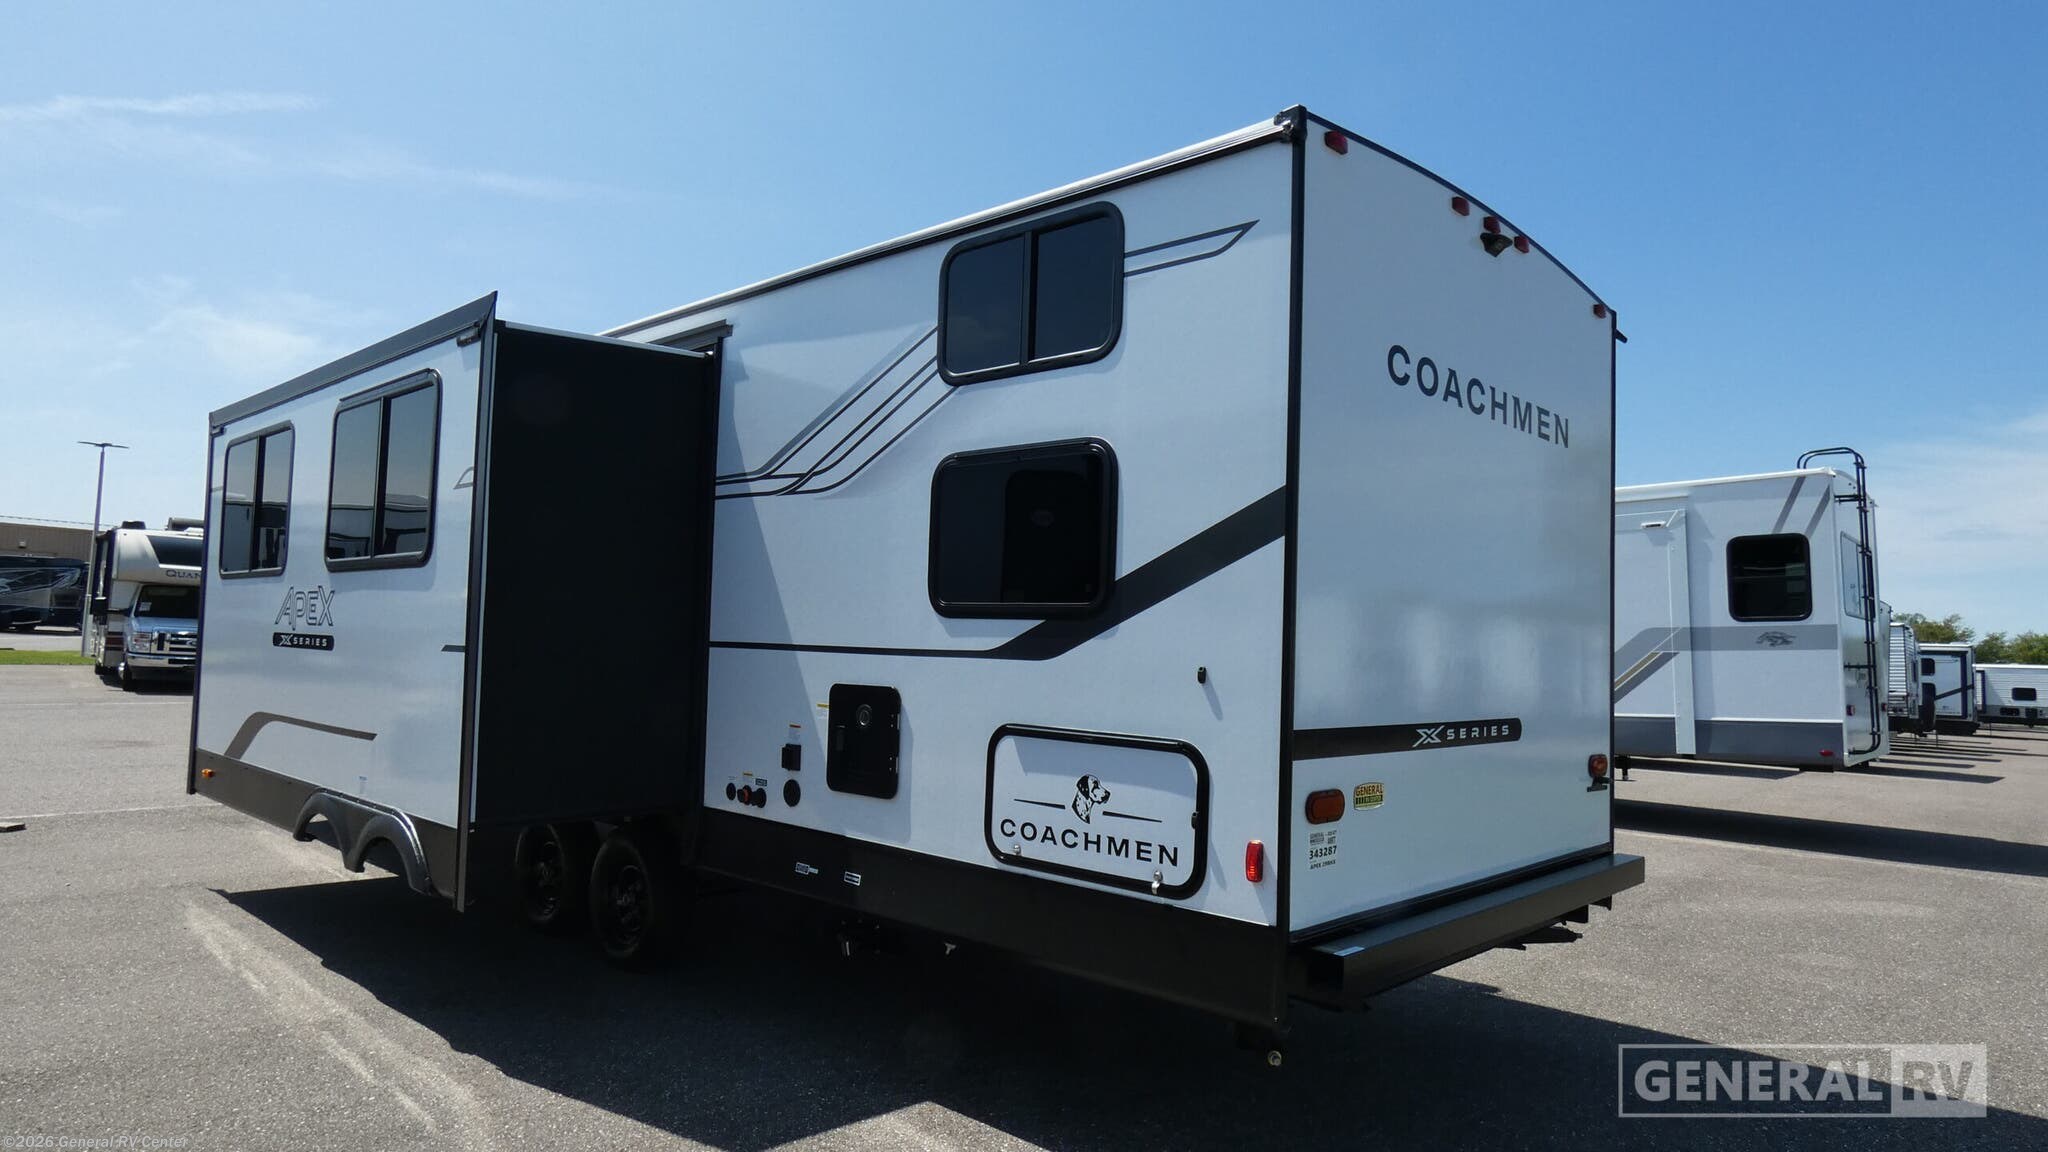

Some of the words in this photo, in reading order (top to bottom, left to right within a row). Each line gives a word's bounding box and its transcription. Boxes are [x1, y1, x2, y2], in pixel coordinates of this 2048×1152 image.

[1387, 344, 1569, 449] COACHMEN
[1446, 725, 1510, 740] SERIES
[1355, 784, 1383, 796] GENERAL
[999, 818, 1179, 867] COACHMEN
[1309, 845, 1337, 860] 343287
